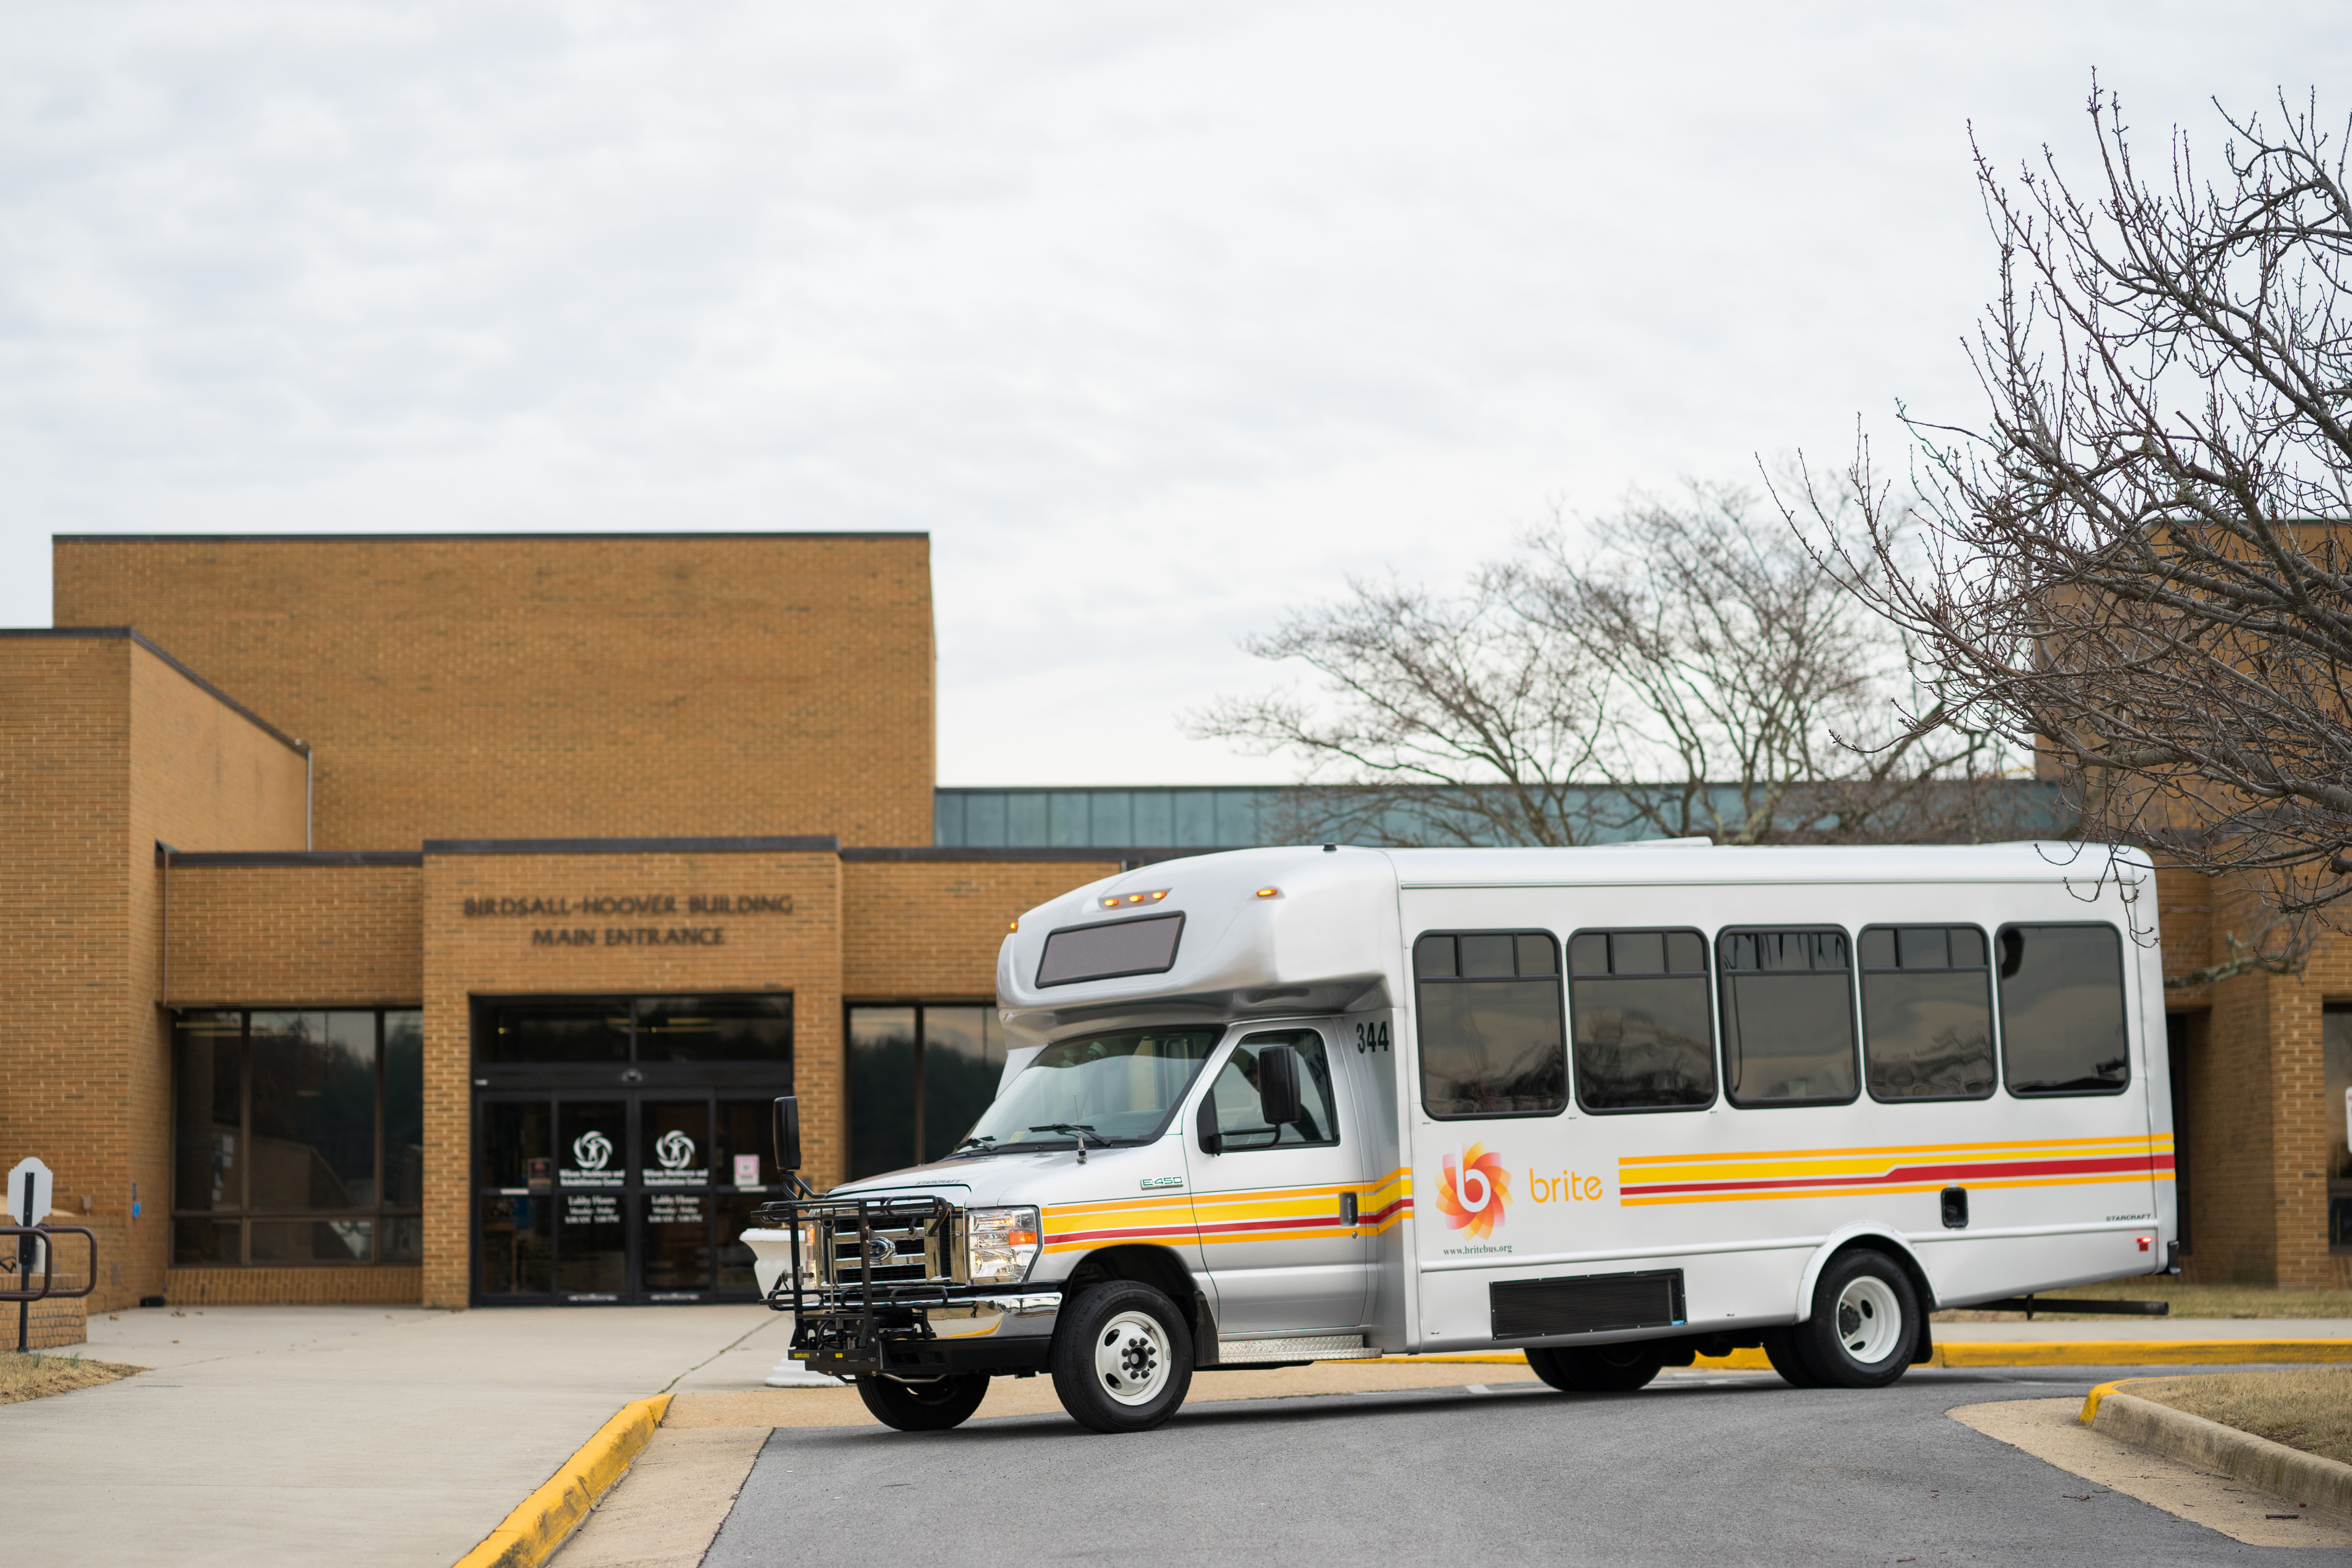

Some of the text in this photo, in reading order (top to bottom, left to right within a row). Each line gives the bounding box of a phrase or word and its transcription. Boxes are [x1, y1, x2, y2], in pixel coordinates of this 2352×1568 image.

[464, 894, 793, 916] BIRDSALL-HOOVER BUILDING
[533, 927, 725, 946] MAIN ENTRANCE
[1356, 1021, 1389, 1054] 344
[1530, 1168, 1603, 1203] brite
[568, 1195, 617, 1207] Lobby Hours
[652, 1194, 700, 1207] Lobby Hours
[2106, 1213, 2151, 1221] STARCRAFT
[1443, 1245, 1512, 1255] www.britebus.org
